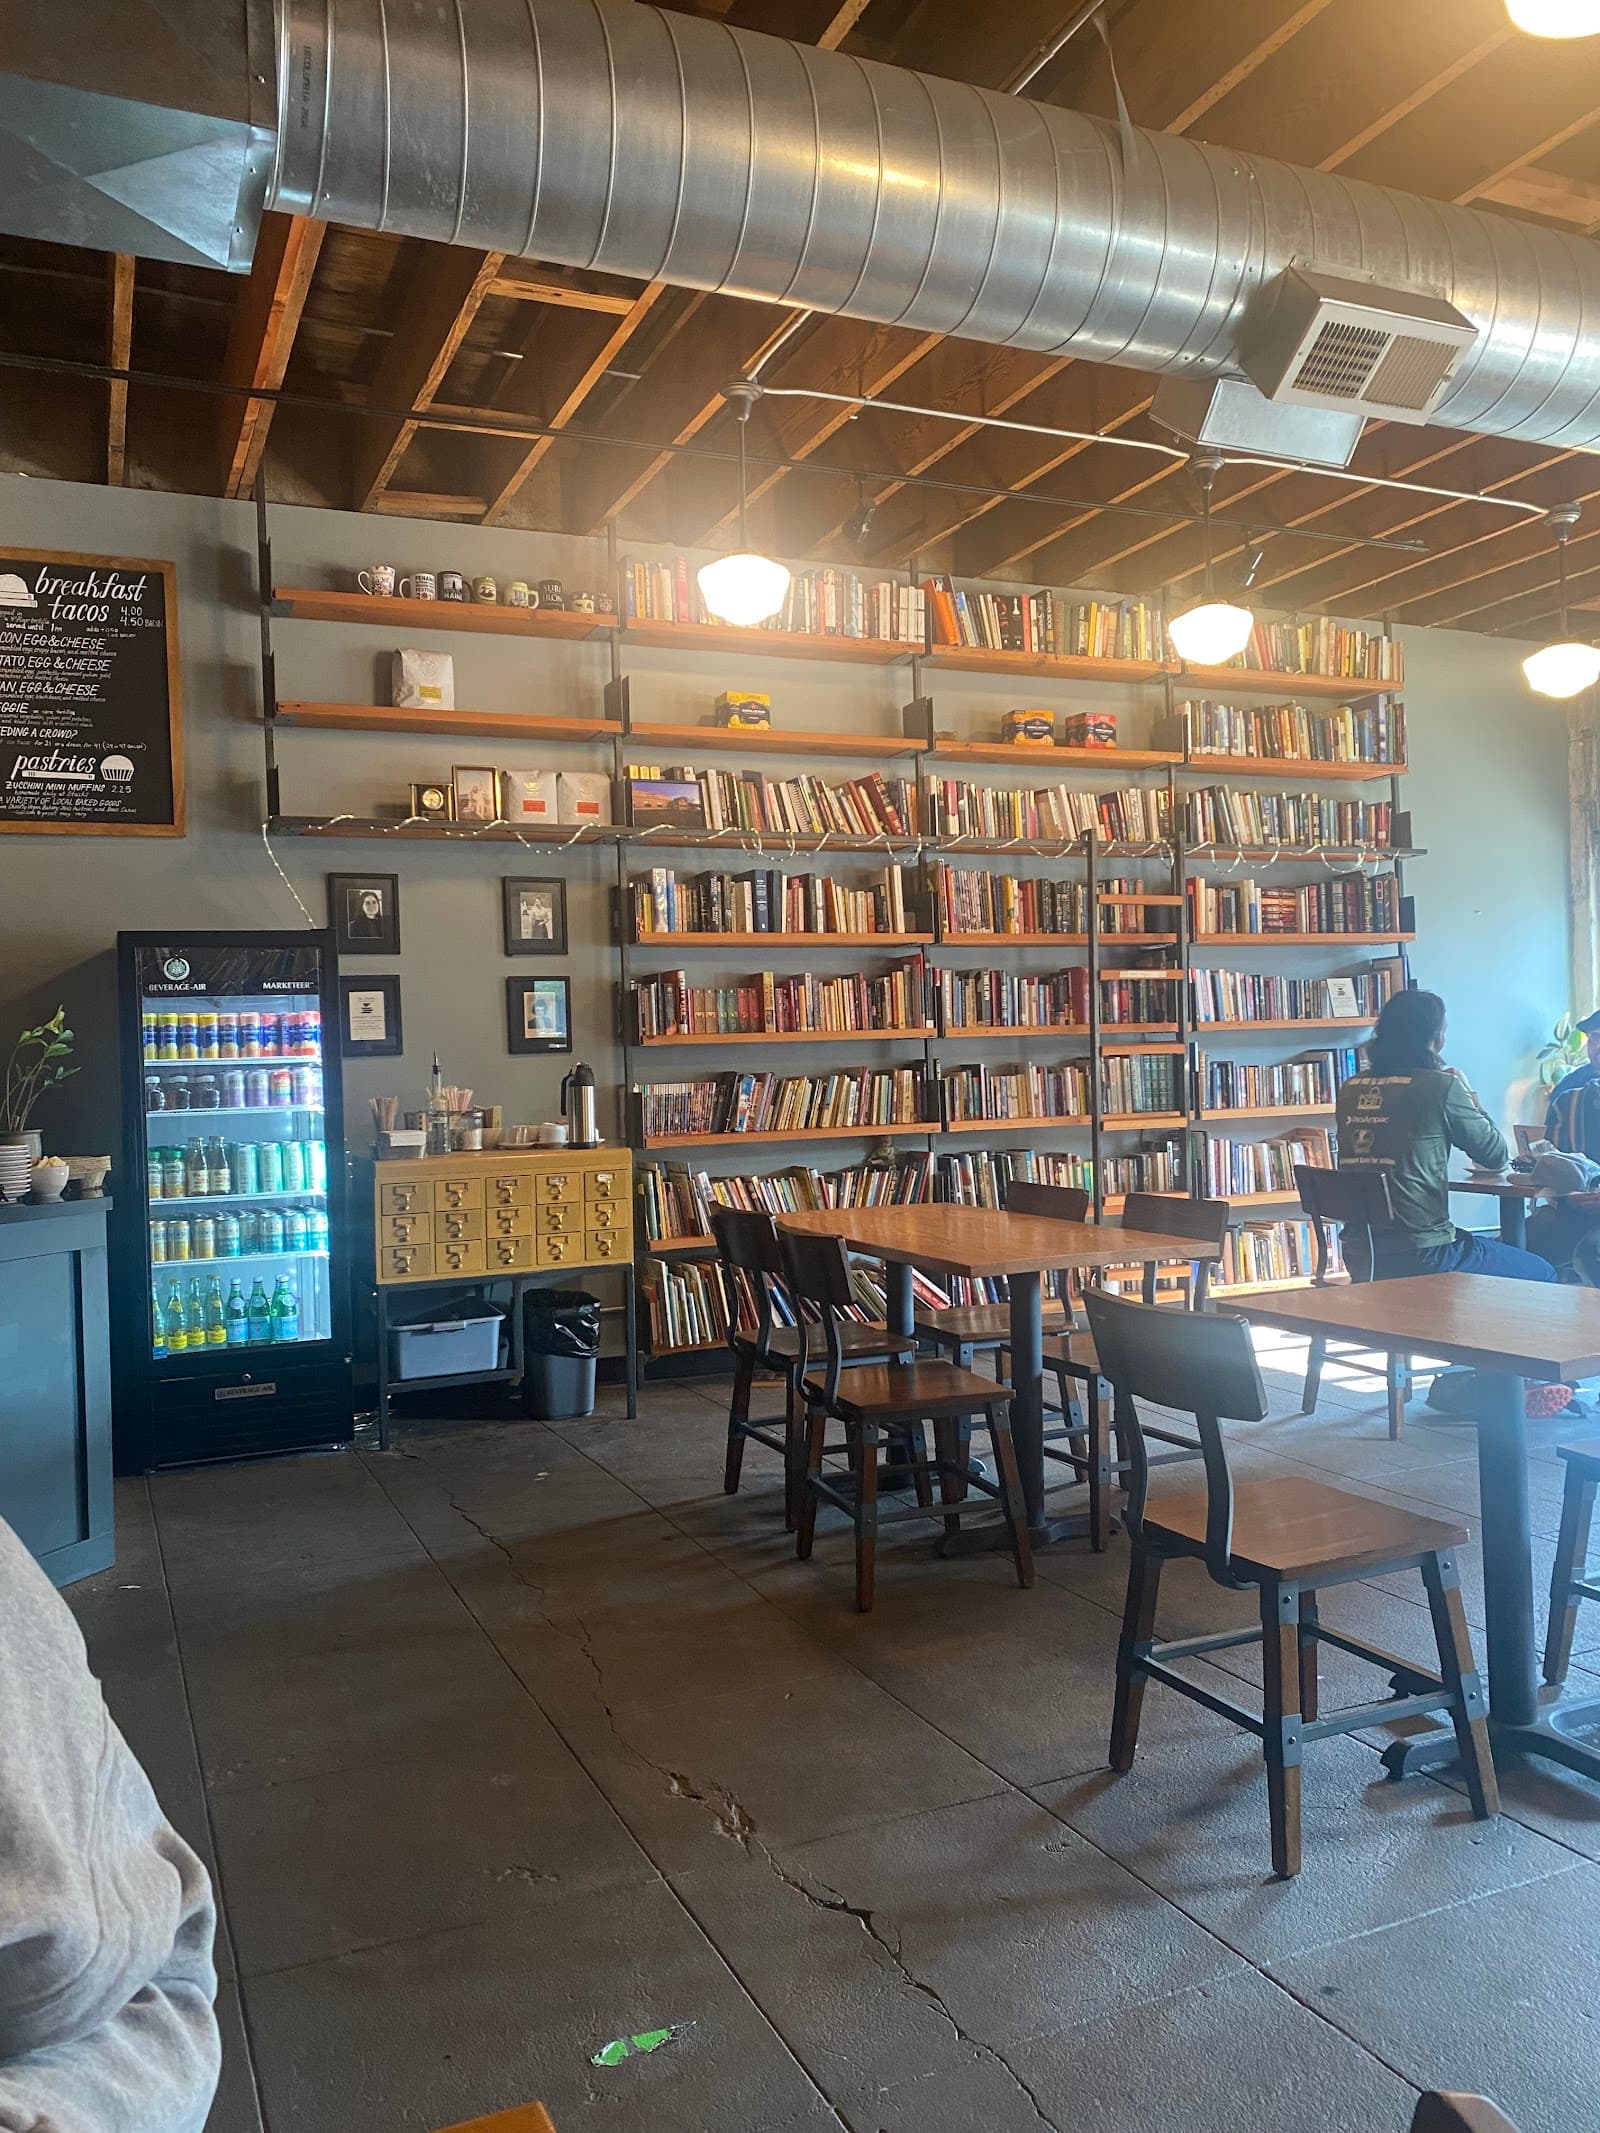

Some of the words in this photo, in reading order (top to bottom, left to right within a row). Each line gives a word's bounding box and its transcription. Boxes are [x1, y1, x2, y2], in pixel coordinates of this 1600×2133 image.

[35, 566, 148, 602] breakfast
[48, 595, 110, 622] tacos
[121, 606, 143, 617] 4.00
[120, 617, 144, 627] 4.50
[60, 636, 107, 650] CHEESE
[28, 656, 52, 668] EGG
[65, 657, 112, 671] CHEESE
[19, 681, 42, 693] EGG
[55, 682, 100, 696] CHEESE
[0, 726, 30, 737] EDING
[30, 727, 37, 738] A
[39, 728, 79, 739] CROWD?
[10, 749, 97, 780] pastries
[5, 781, 44, 790] ZUCCHINI
[45, 783, 65, 791] MINI
[68, 783, 105, 792] MUFFINS
[5, 796, 41, 806] VARIETY
[40, 797, 51, 805] OF
[52, 797, 73, 806] LOCAL
[75, 798, 98, 807] BAKED
[99, 799, 122, 808] GOODS
[148, 983, 207, 991] BEVERAGE-AIR
[263, 981, 311, 990] MARKETEER
